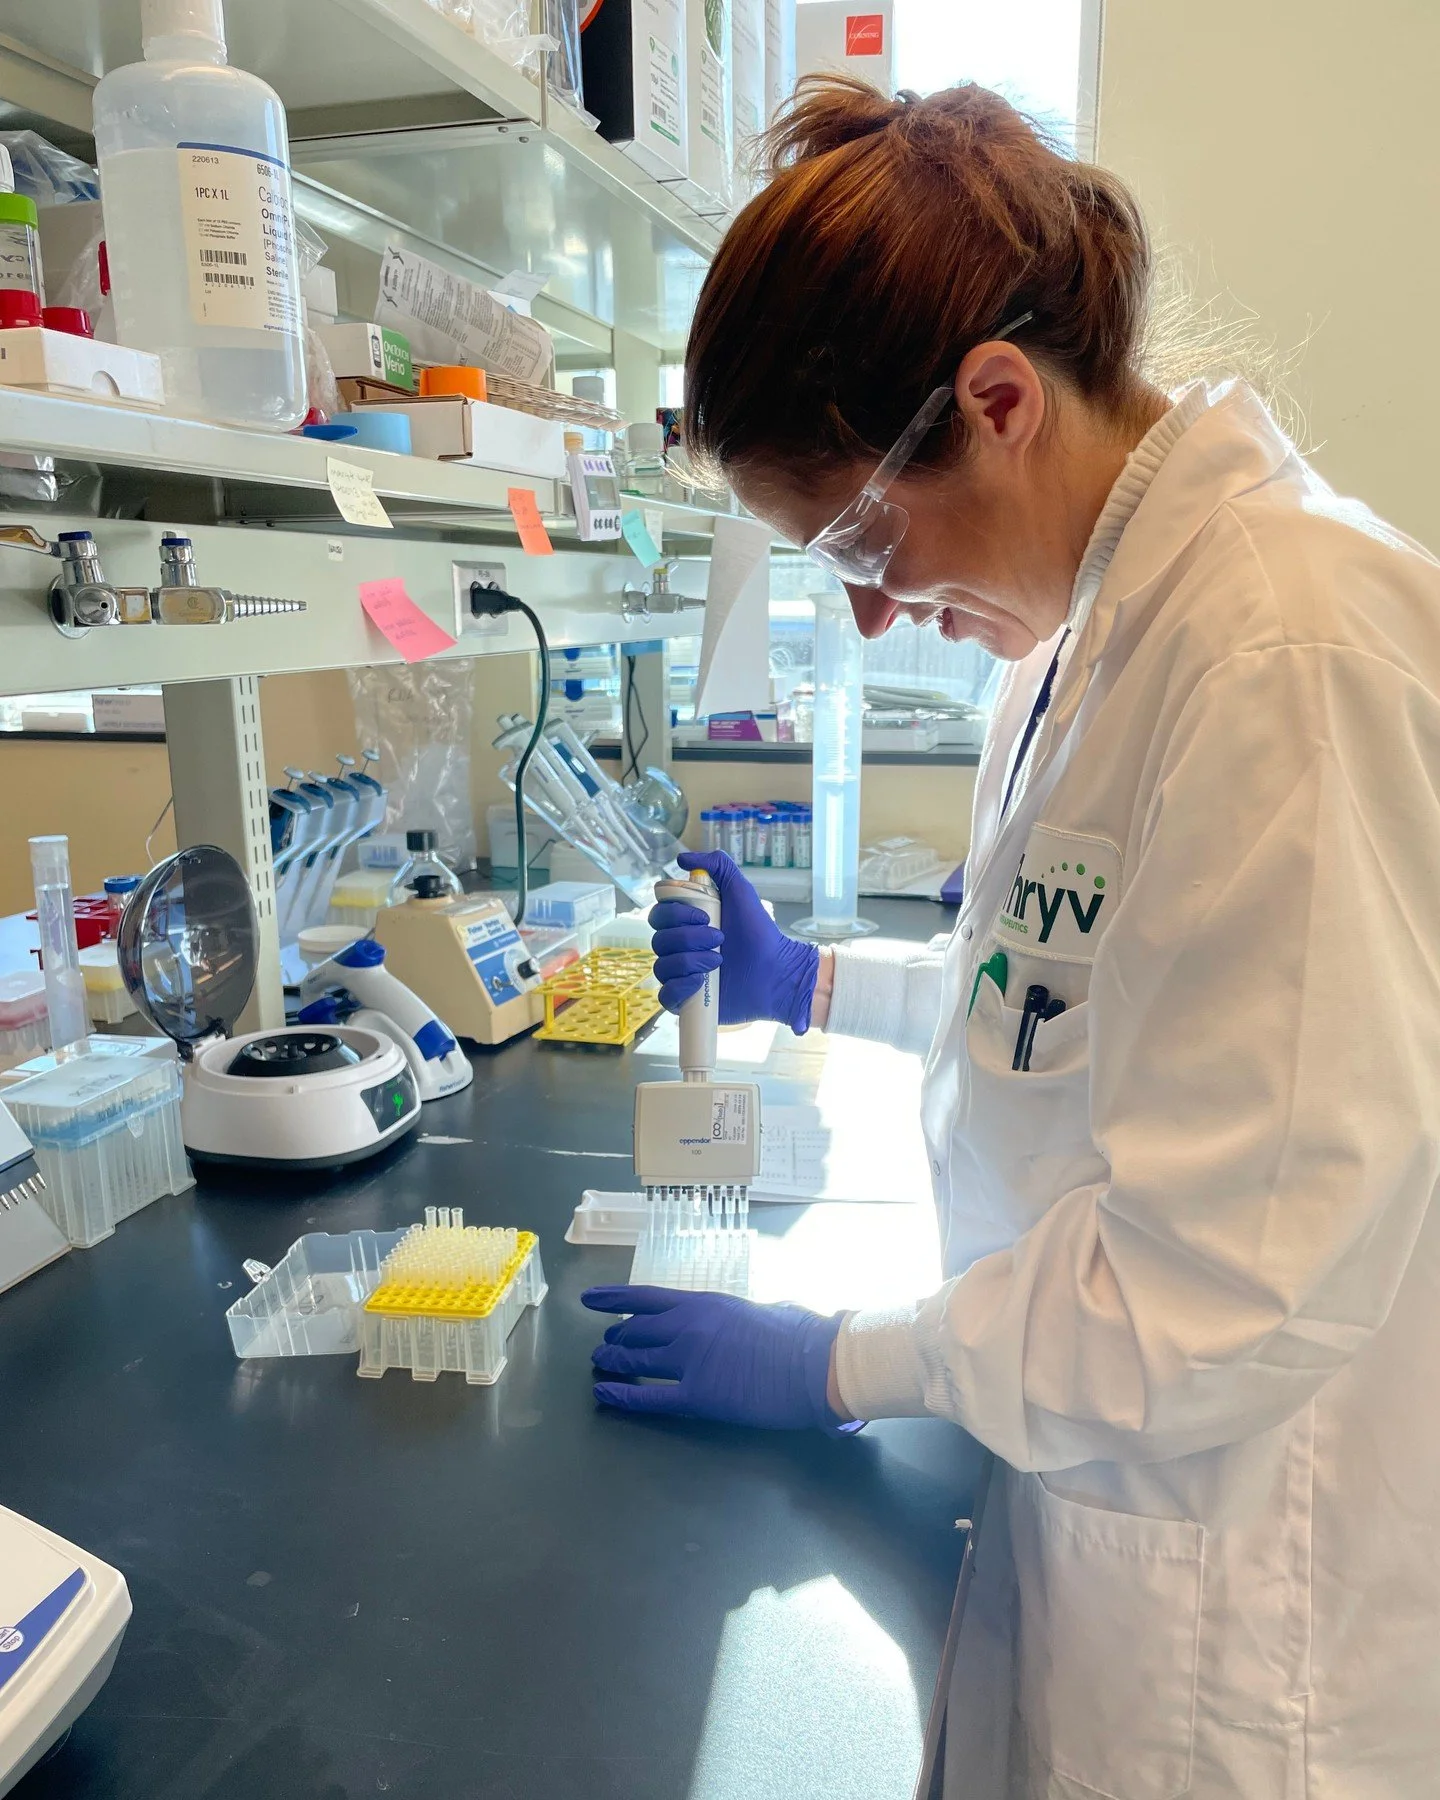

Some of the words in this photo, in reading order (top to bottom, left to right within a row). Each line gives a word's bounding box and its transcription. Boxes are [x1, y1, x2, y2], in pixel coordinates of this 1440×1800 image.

[191, 155, 219, 164] 220613
[195, 187, 210, 199] 1PC
[212, 188, 218, 199] X
[220, 189, 229, 201] 1L
[3, 1635, 20, 1650] Stop
